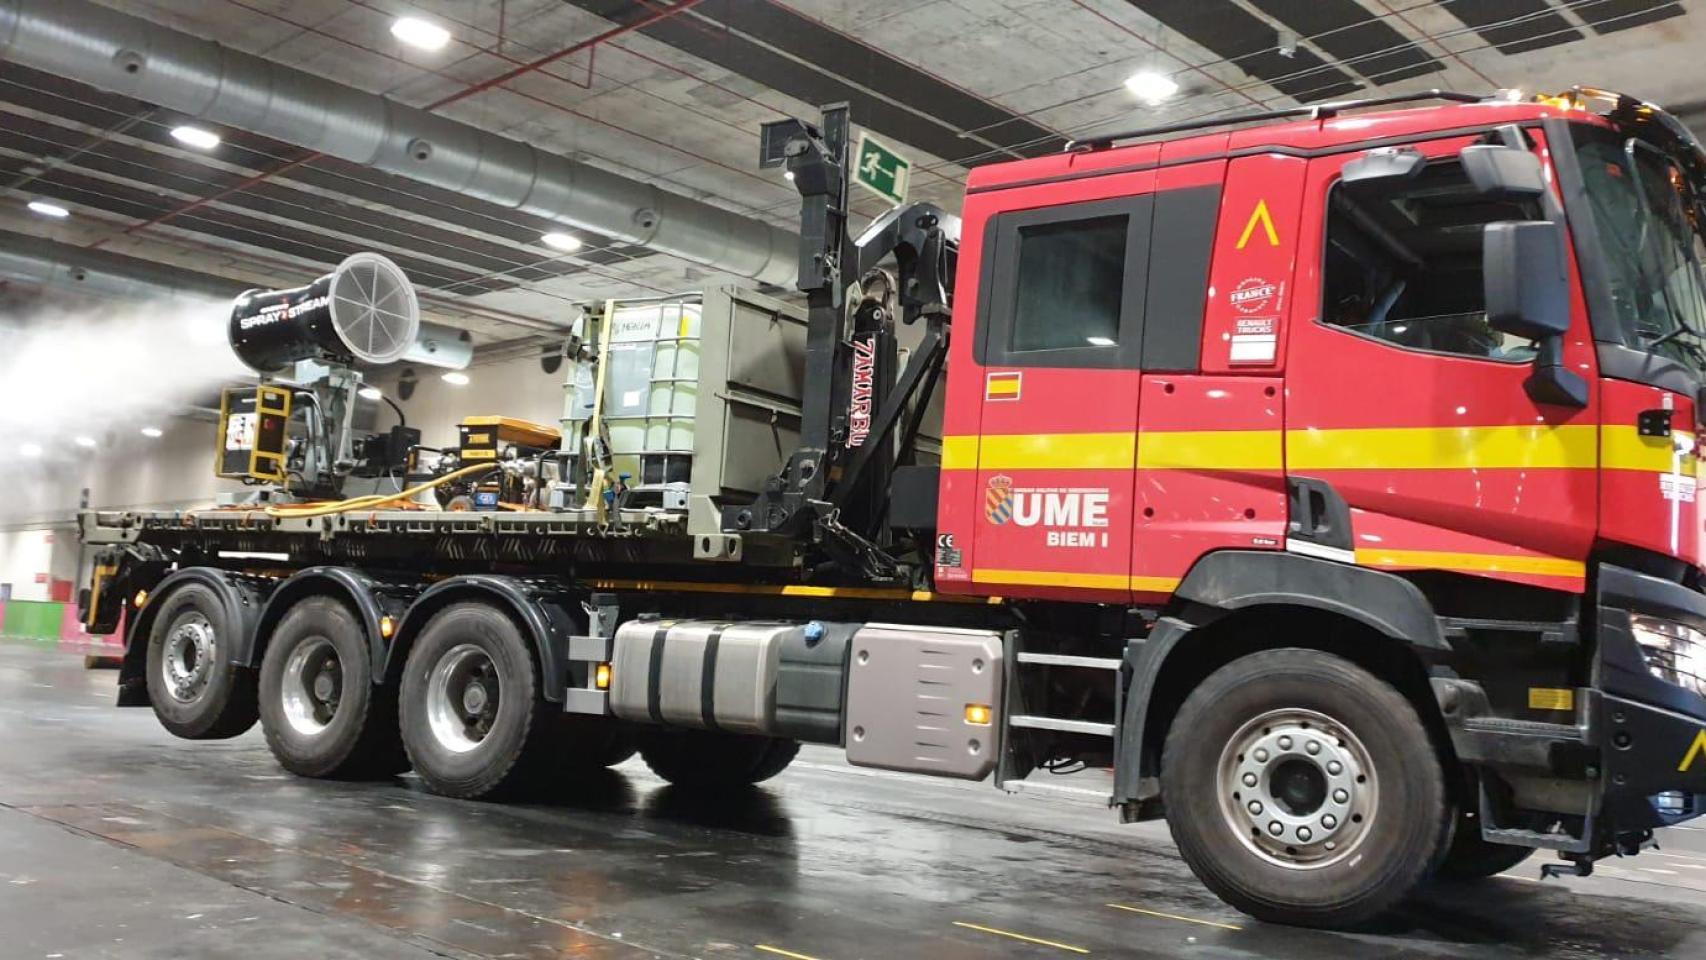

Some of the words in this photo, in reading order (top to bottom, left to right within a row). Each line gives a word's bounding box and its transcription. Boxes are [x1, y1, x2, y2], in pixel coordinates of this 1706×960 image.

[1230, 288, 1272, 302] FRANCE
[240, 311, 281, 330] SPRAY
[1012, 493, 1109, 527] UME
[1046, 531, 1096, 548] BIEM
[1101, 532, 1109, 548] I
